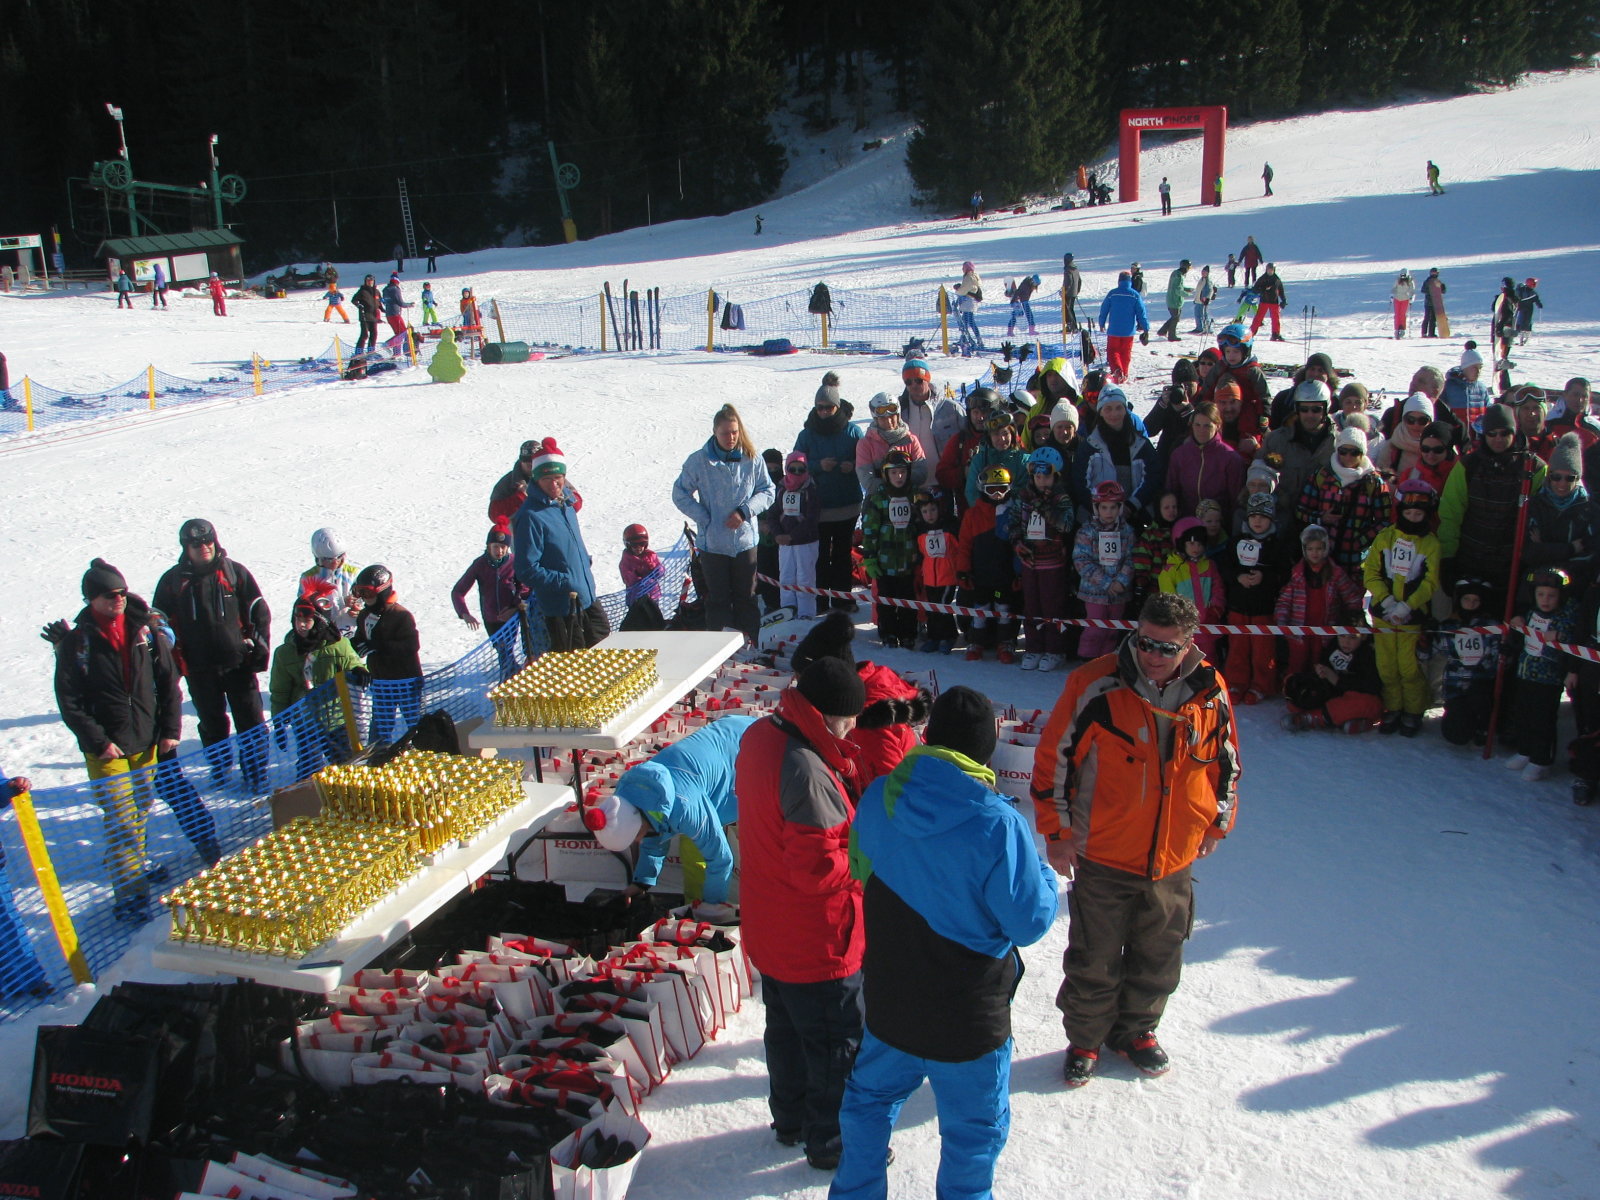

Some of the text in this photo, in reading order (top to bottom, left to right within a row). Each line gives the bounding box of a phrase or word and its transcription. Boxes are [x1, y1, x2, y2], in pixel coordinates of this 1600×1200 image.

[785, 494, 796, 504] 68
[891, 505, 909, 517] 109
[928, 537, 940, 550] 31
[1104, 541, 1117, 553] 39
[1393, 546, 1412, 562] 131
[1457, 638, 1480, 651] 146
[998, 769, 1032, 779] HON
[50, 1072, 123, 1091] HONDA
[0, 1183, 41, 1198] NDA
